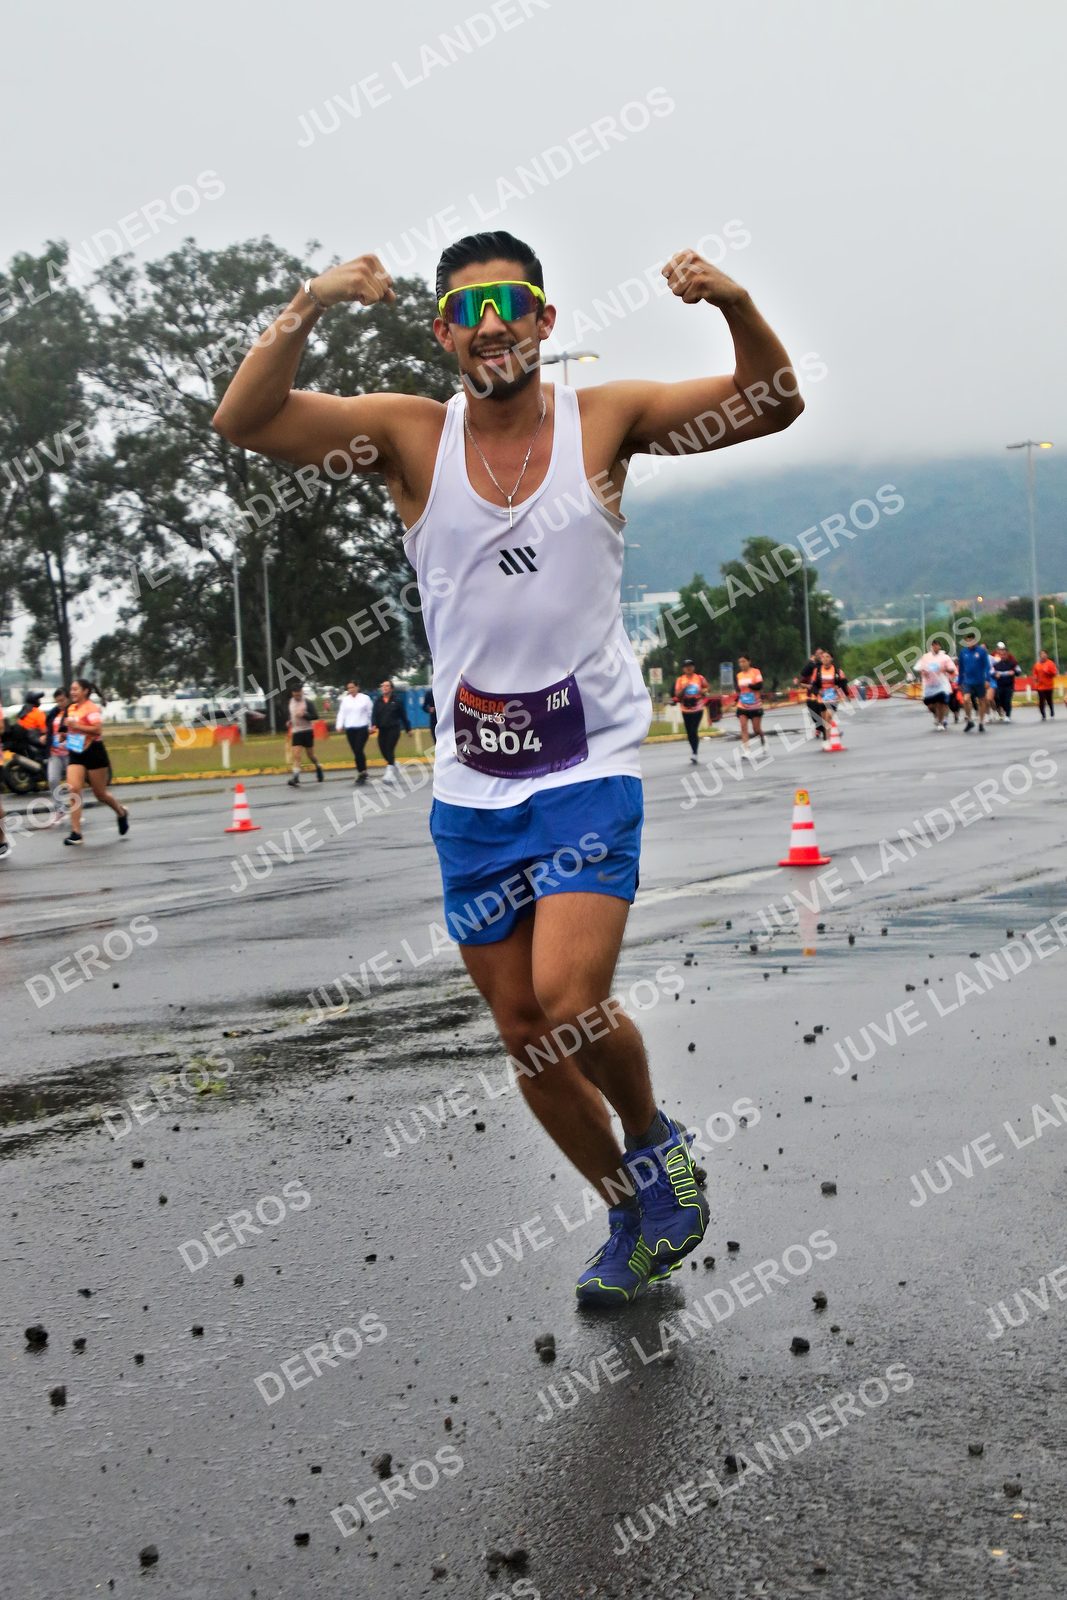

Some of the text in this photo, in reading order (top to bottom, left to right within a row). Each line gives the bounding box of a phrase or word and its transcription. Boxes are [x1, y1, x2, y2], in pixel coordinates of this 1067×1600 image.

[459, 687, 505, 714] CARRERA
[546, 687, 570, 712] 15K
[459, 703, 493, 723] OMNILIFE
[480, 727, 542, 755] 804
